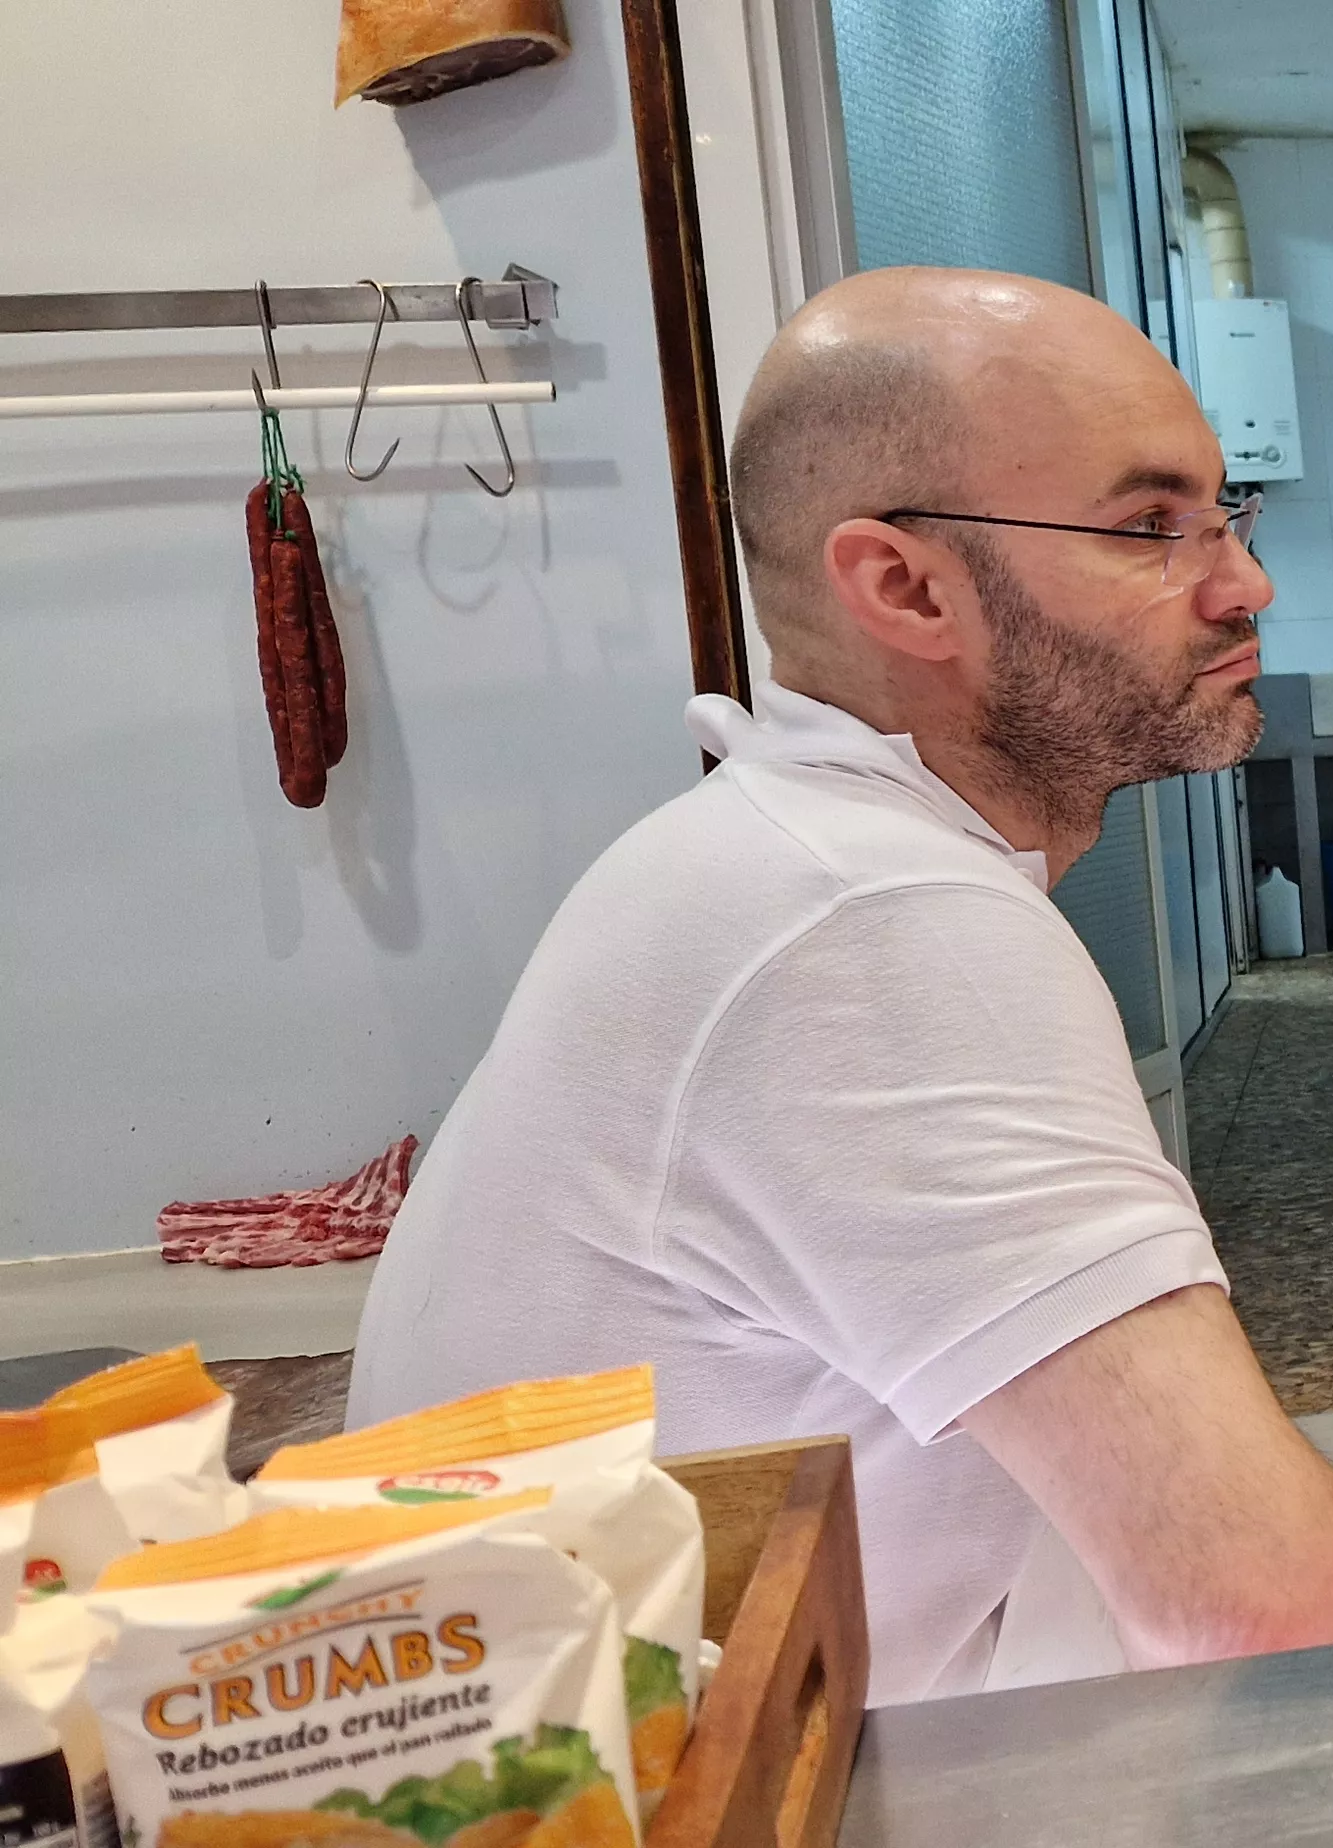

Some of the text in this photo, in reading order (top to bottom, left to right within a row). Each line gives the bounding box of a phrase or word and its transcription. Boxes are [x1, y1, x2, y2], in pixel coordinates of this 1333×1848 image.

[141, 1612, 487, 1741] CRUMBS
[189, 1588, 425, 1677] CRUNCHY
[156, 1683, 492, 1777] Rebozado crujiente
